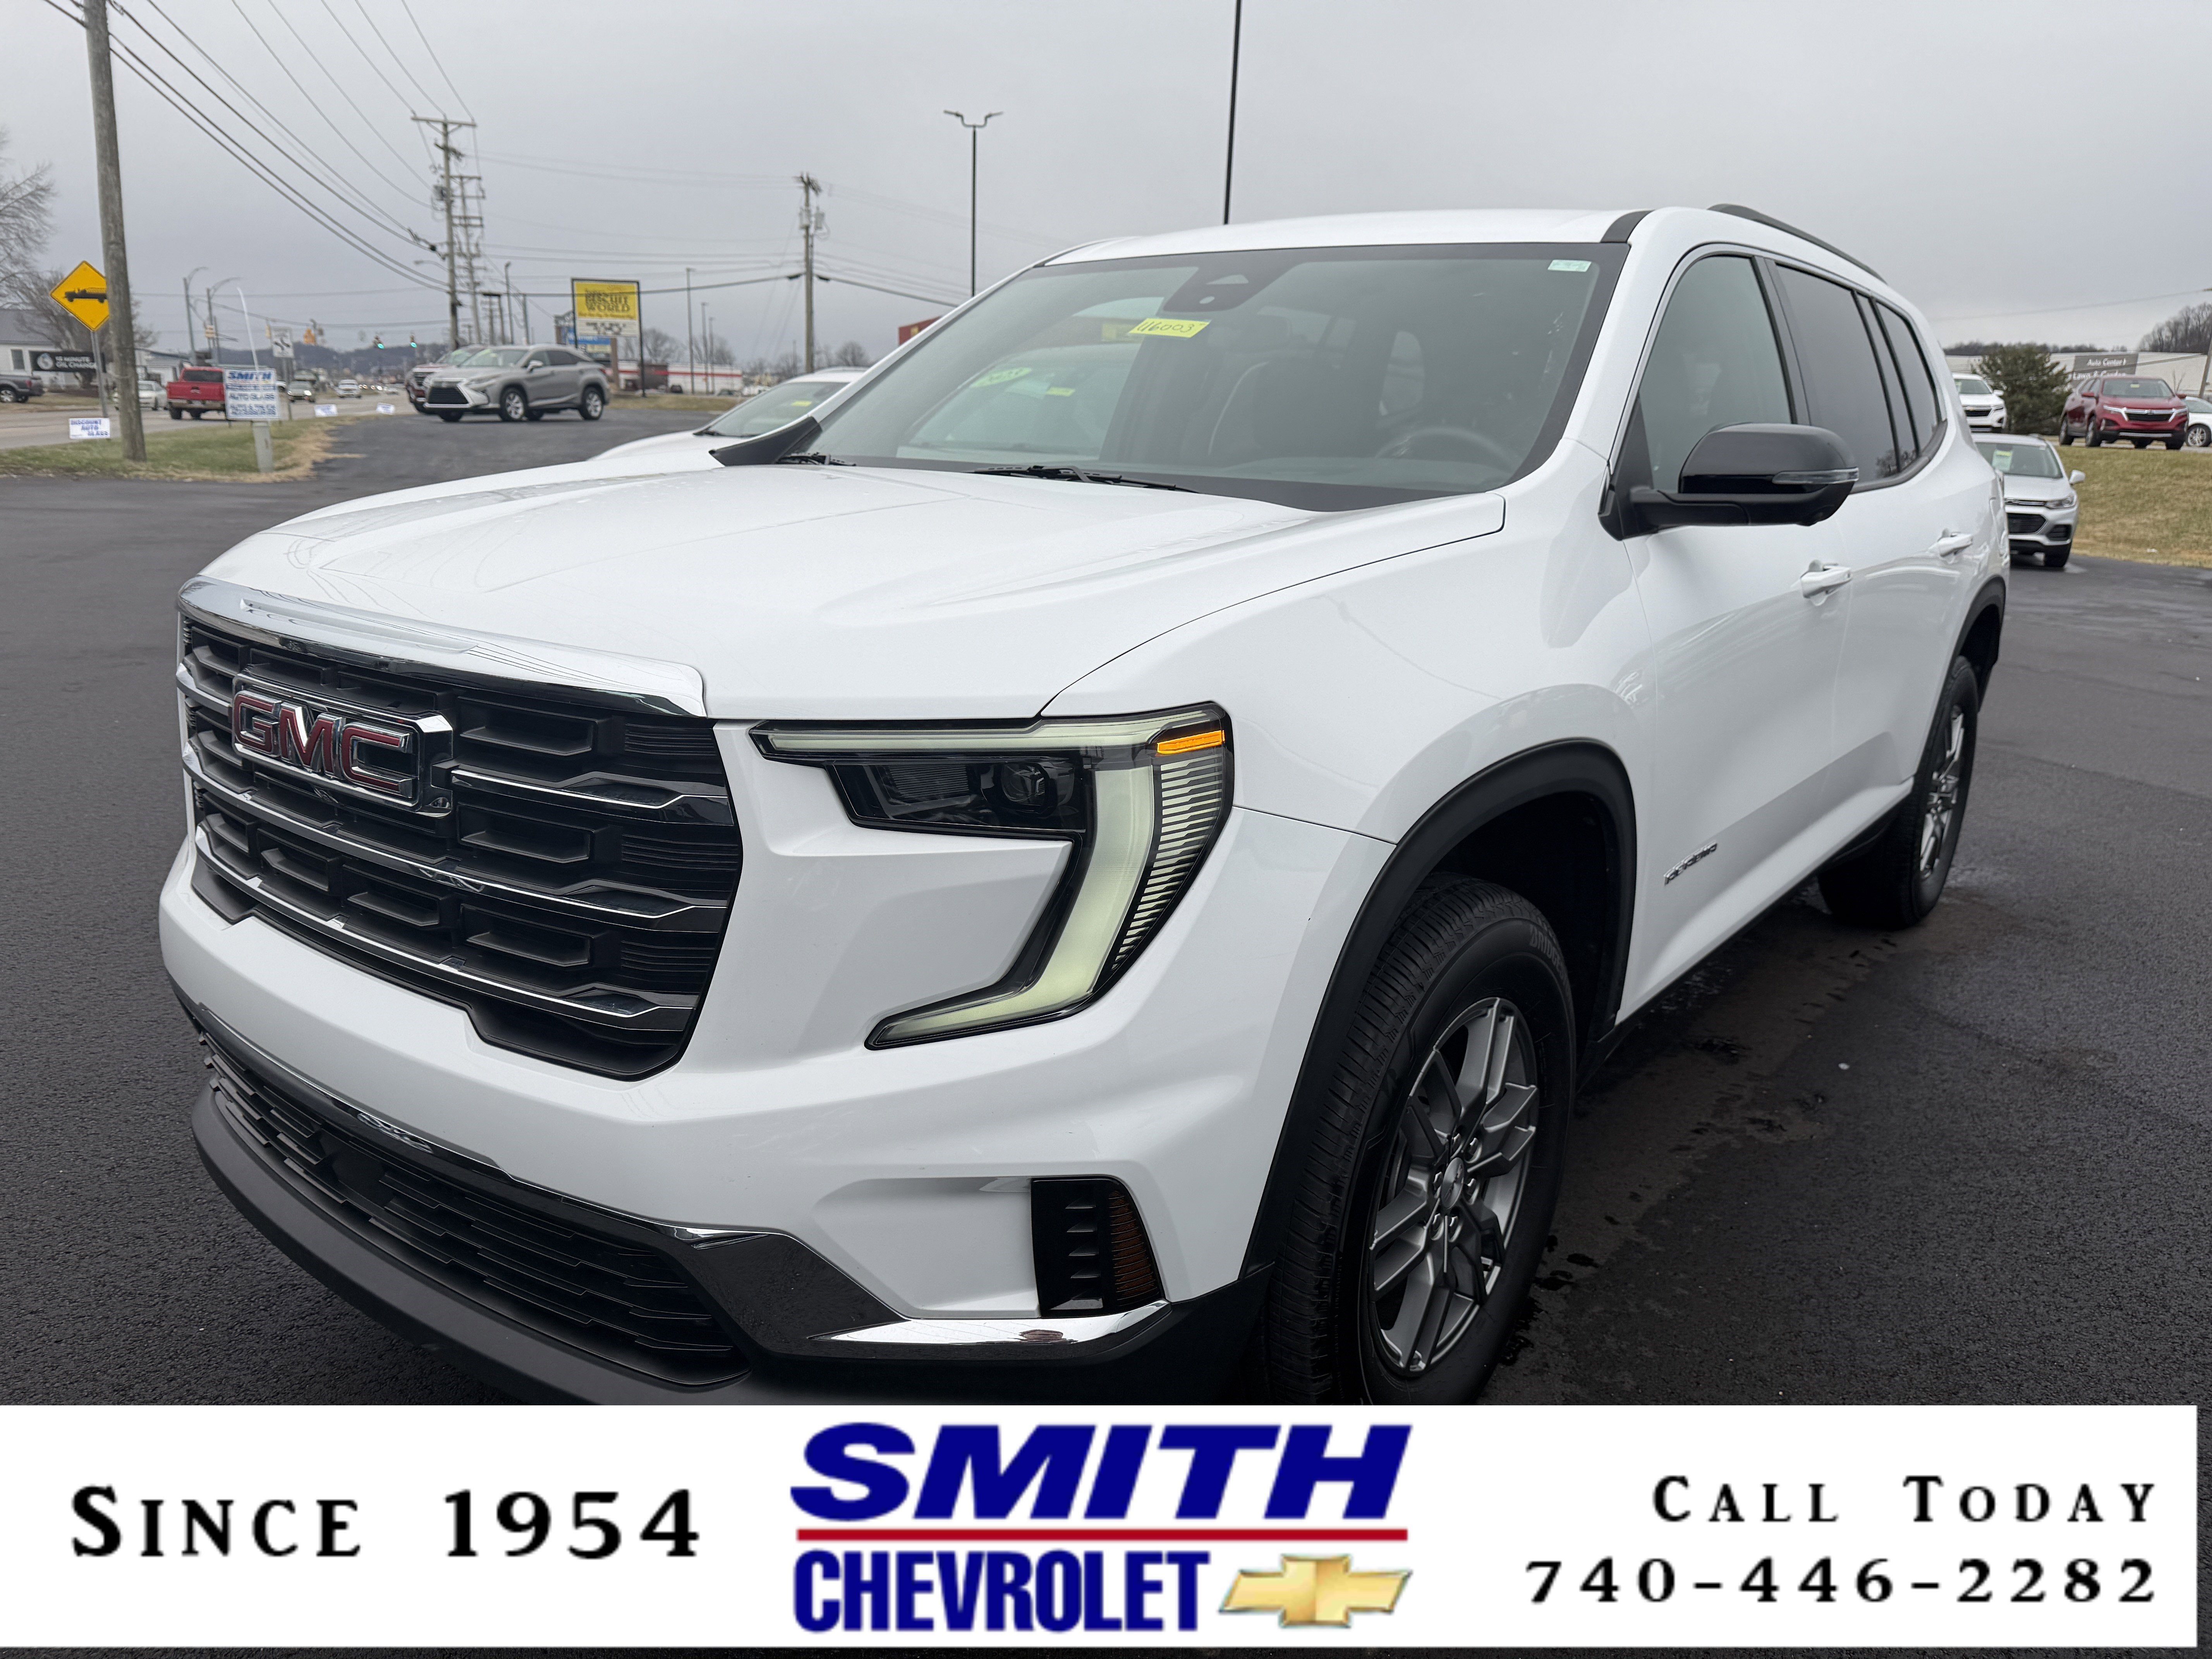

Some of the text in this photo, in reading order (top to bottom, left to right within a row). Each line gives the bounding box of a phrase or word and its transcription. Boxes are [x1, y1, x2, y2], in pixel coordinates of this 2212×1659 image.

[587, 302, 630, 313] WORLD
[2087, 358, 2123, 367] Auto Center
[2073, 372, 2091, 380] Lawn
[233, 690, 412, 798] GMC
